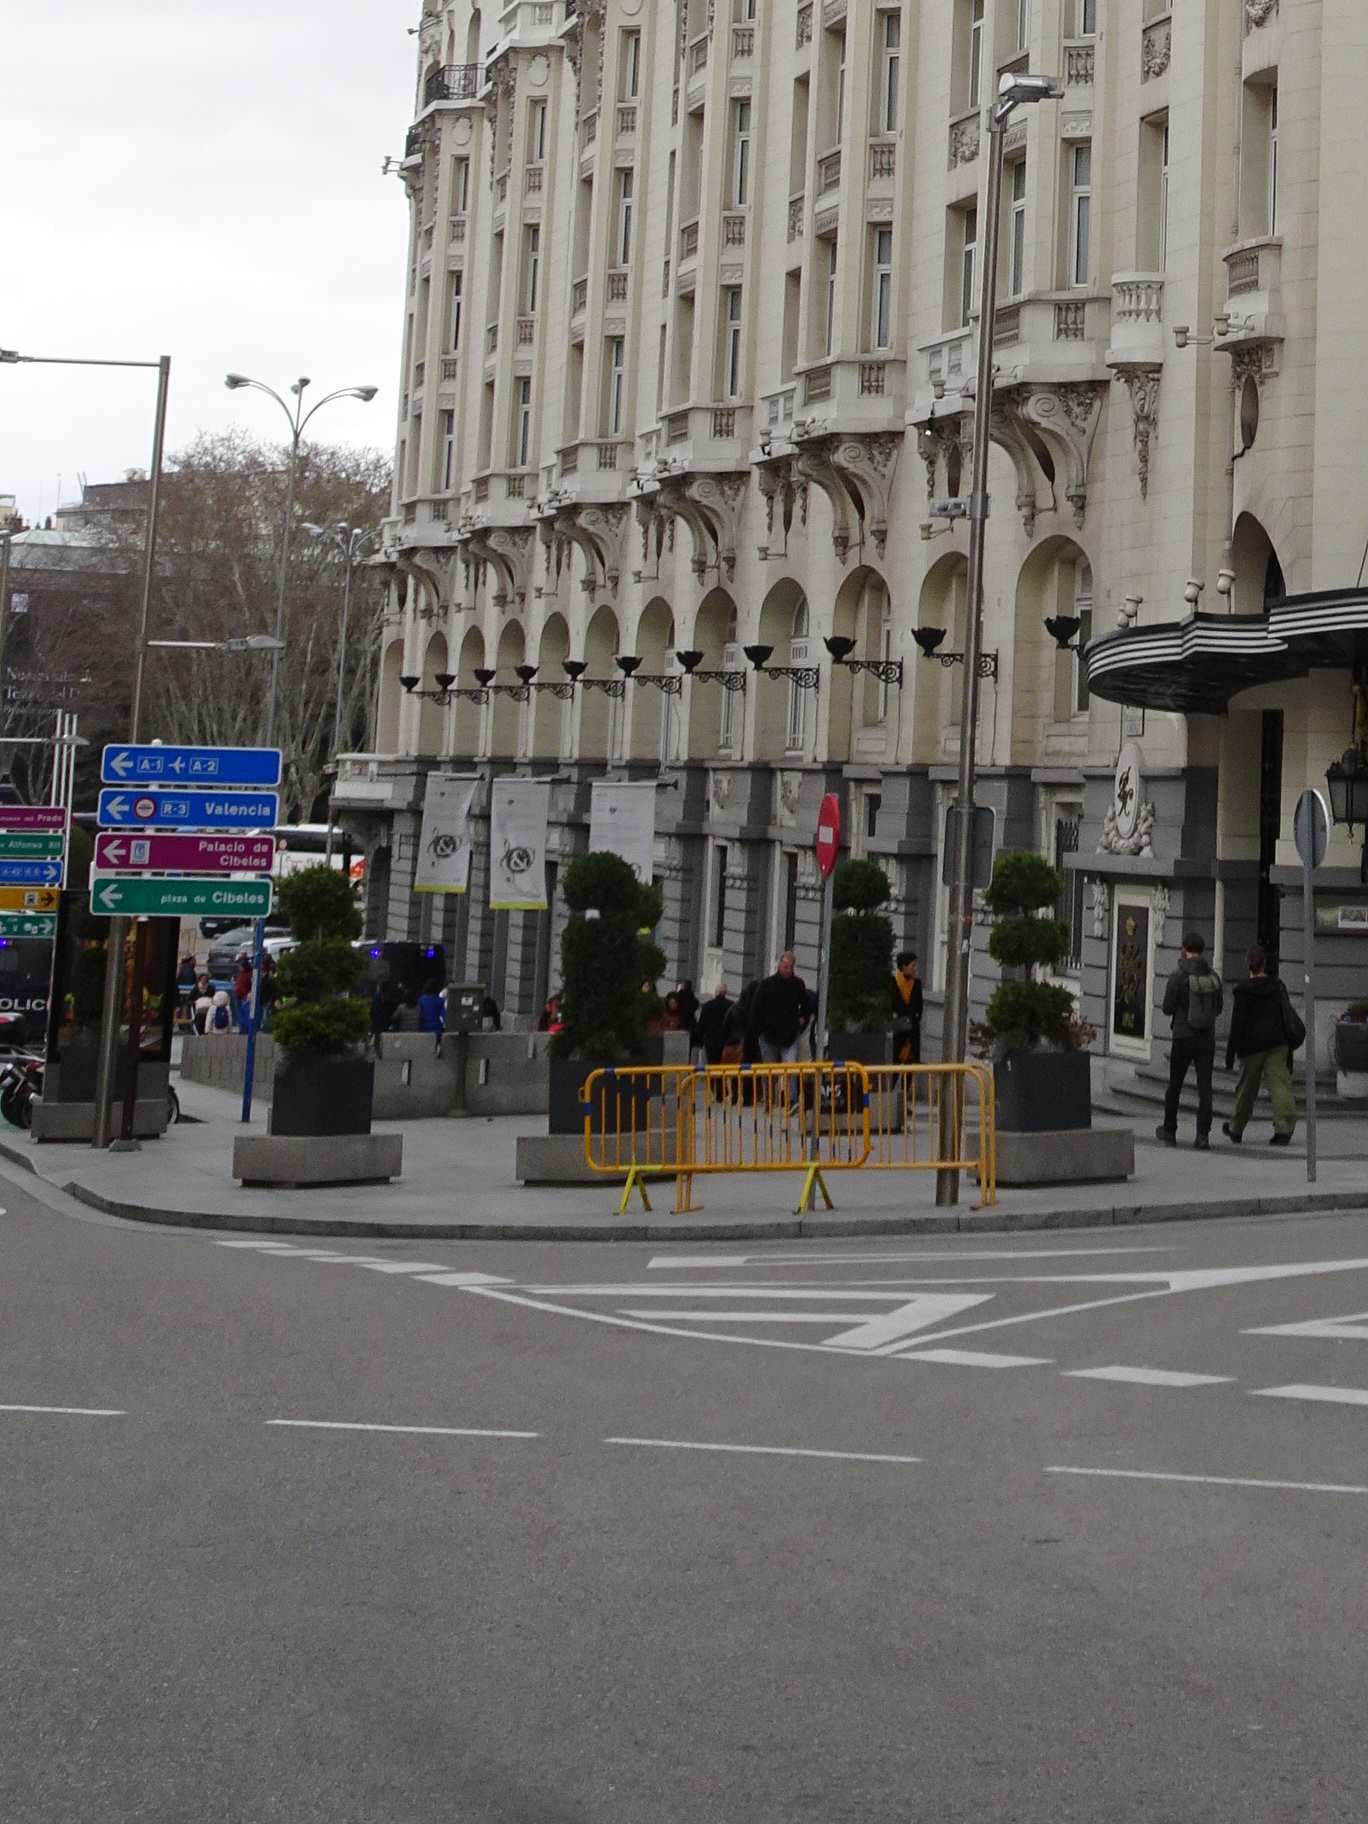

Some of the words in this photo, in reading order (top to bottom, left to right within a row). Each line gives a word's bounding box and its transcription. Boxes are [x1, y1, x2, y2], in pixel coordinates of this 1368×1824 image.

[140, 759, 161, 770] A-1
[192, 760, 217, 772] A-2
[163, 805, 187, 815] R-3
[205, 802, 271, 817] Valencia
[199, 841, 245, 853] Palacio
[253, 842, 269, 853] de
[220, 855, 267, 866] Cibeles
[212, 891, 265, 904] Cibeles
[0, 998, 51, 1011] OLIC
